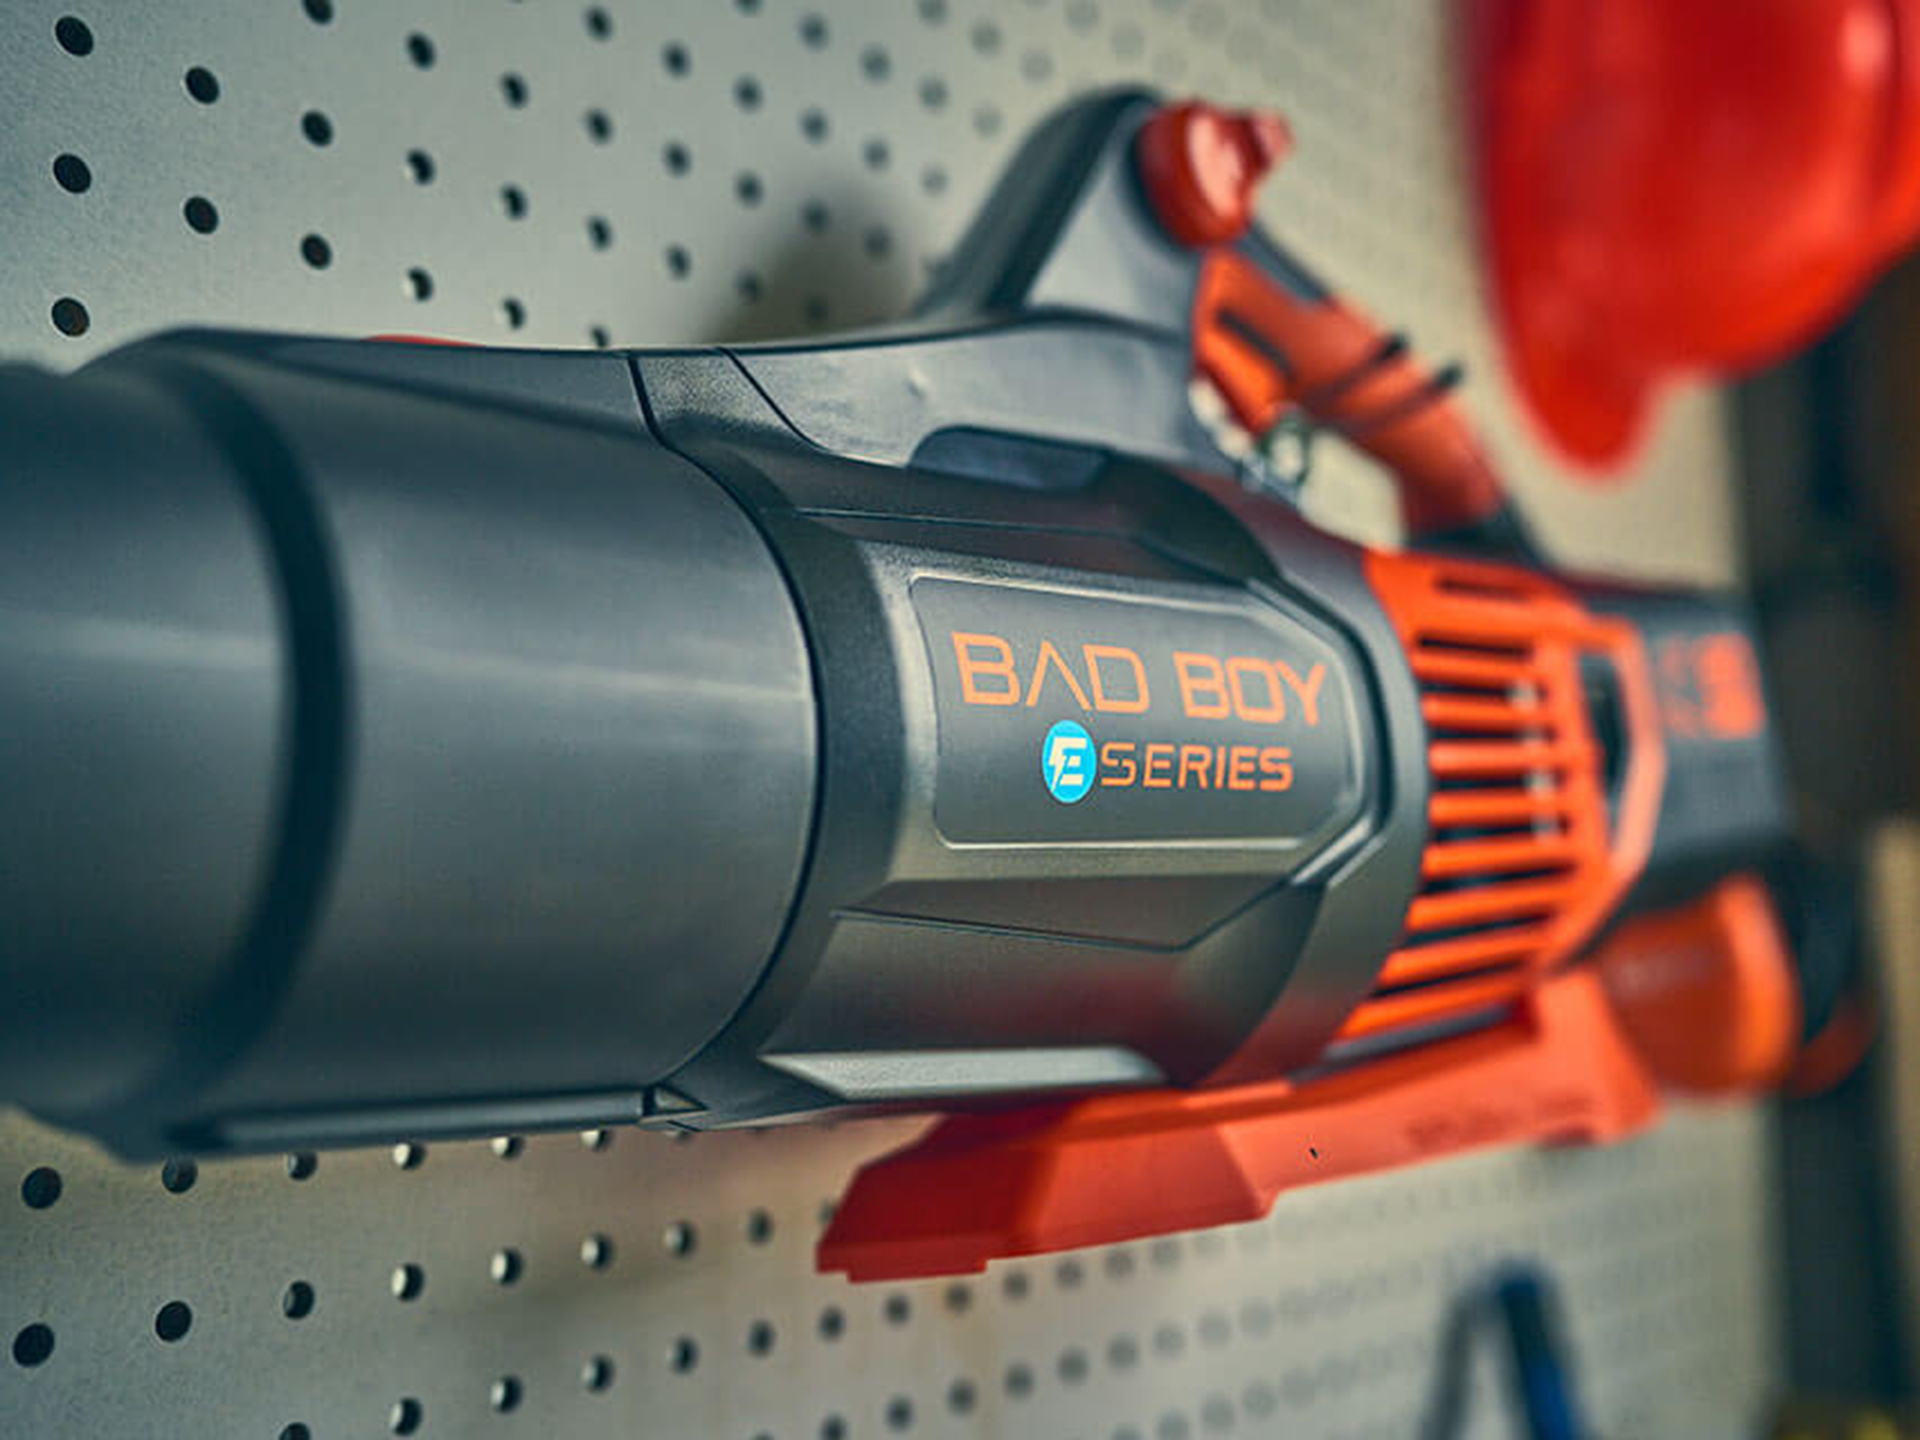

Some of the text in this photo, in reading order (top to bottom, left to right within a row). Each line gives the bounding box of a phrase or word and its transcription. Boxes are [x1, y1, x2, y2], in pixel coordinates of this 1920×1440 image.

[952, 631, 1327, 726] BAD BOY
[1100, 742, 1294, 791] SERIES
